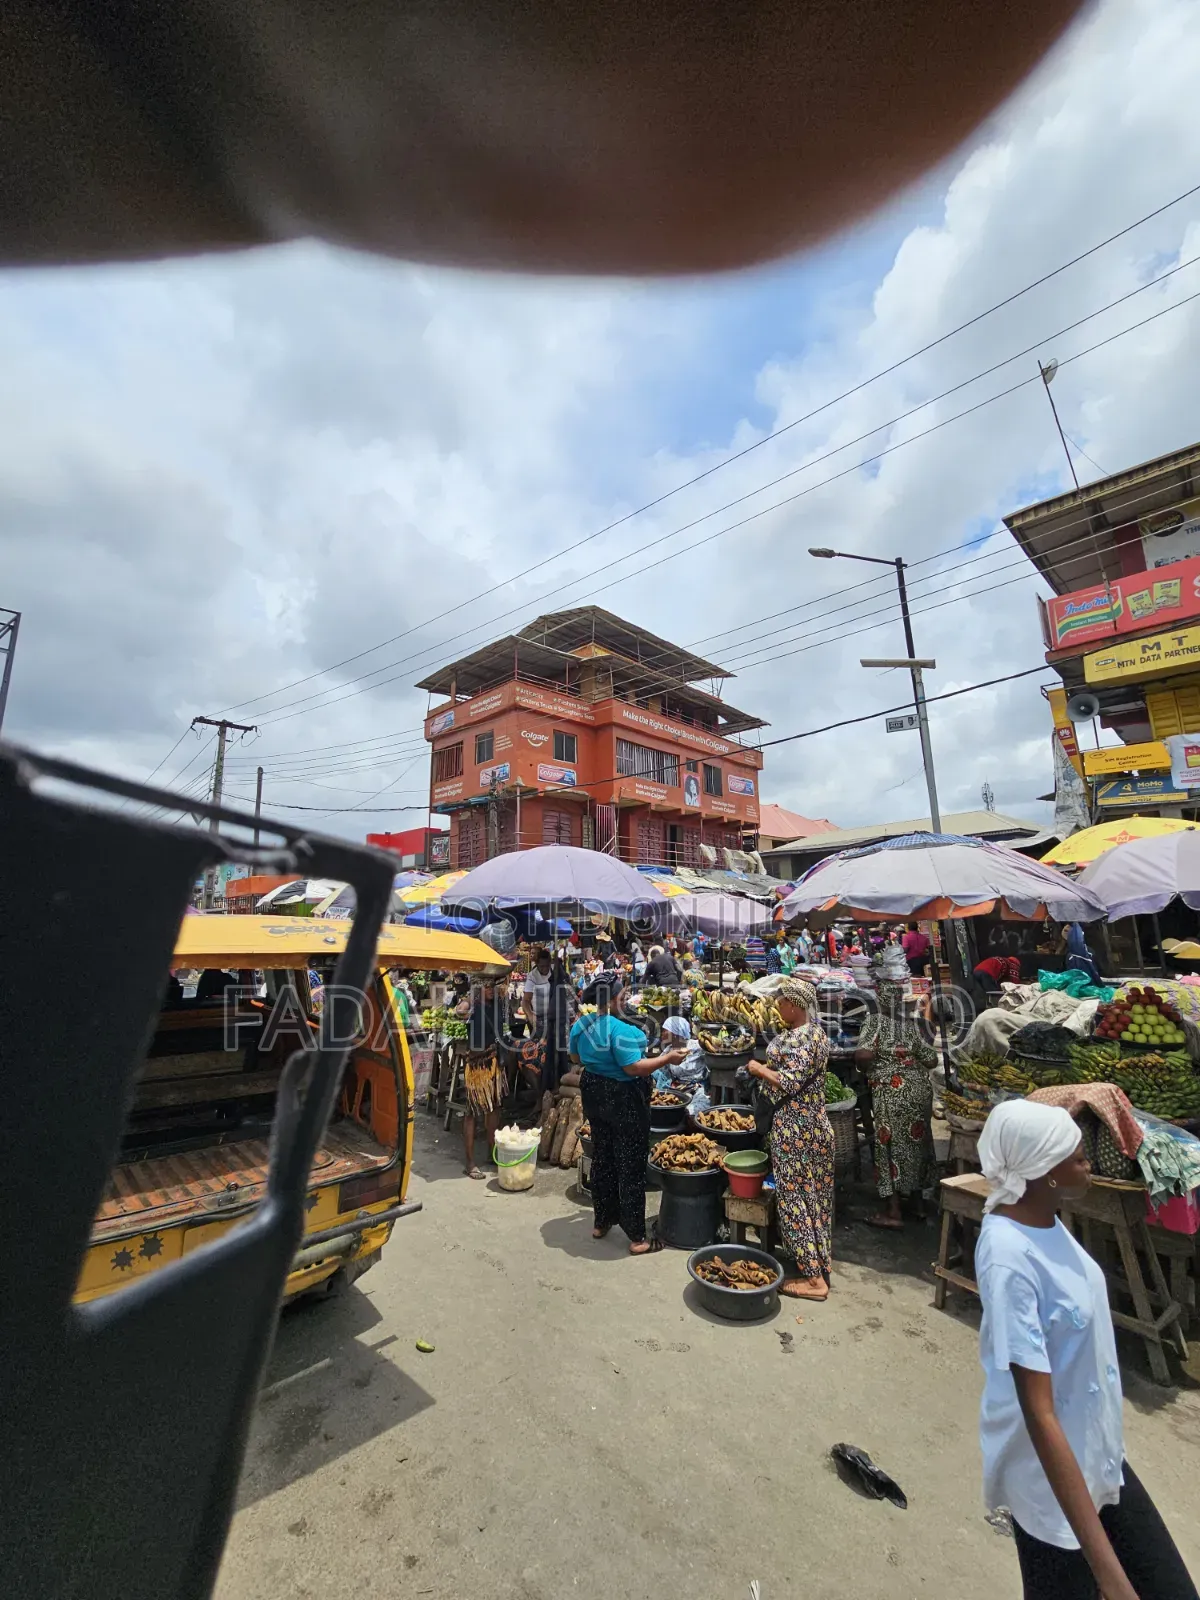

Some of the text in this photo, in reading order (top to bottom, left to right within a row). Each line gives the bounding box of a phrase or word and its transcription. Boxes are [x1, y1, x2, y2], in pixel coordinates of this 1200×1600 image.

[1117, 659, 1136, 669] MTN
[1140, 654, 1162, 664] DATA
[520, 730, 550, 742] Colgate
[622, 709, 639, 722] Make
[638, 715, 649, 725] the
[648, 719, 664, 730] Right
[705, 738, 729, 753] Colgate
[1116, 753, 1152, 763] Registration
[1137, 780, 1164, 789] MoMo
